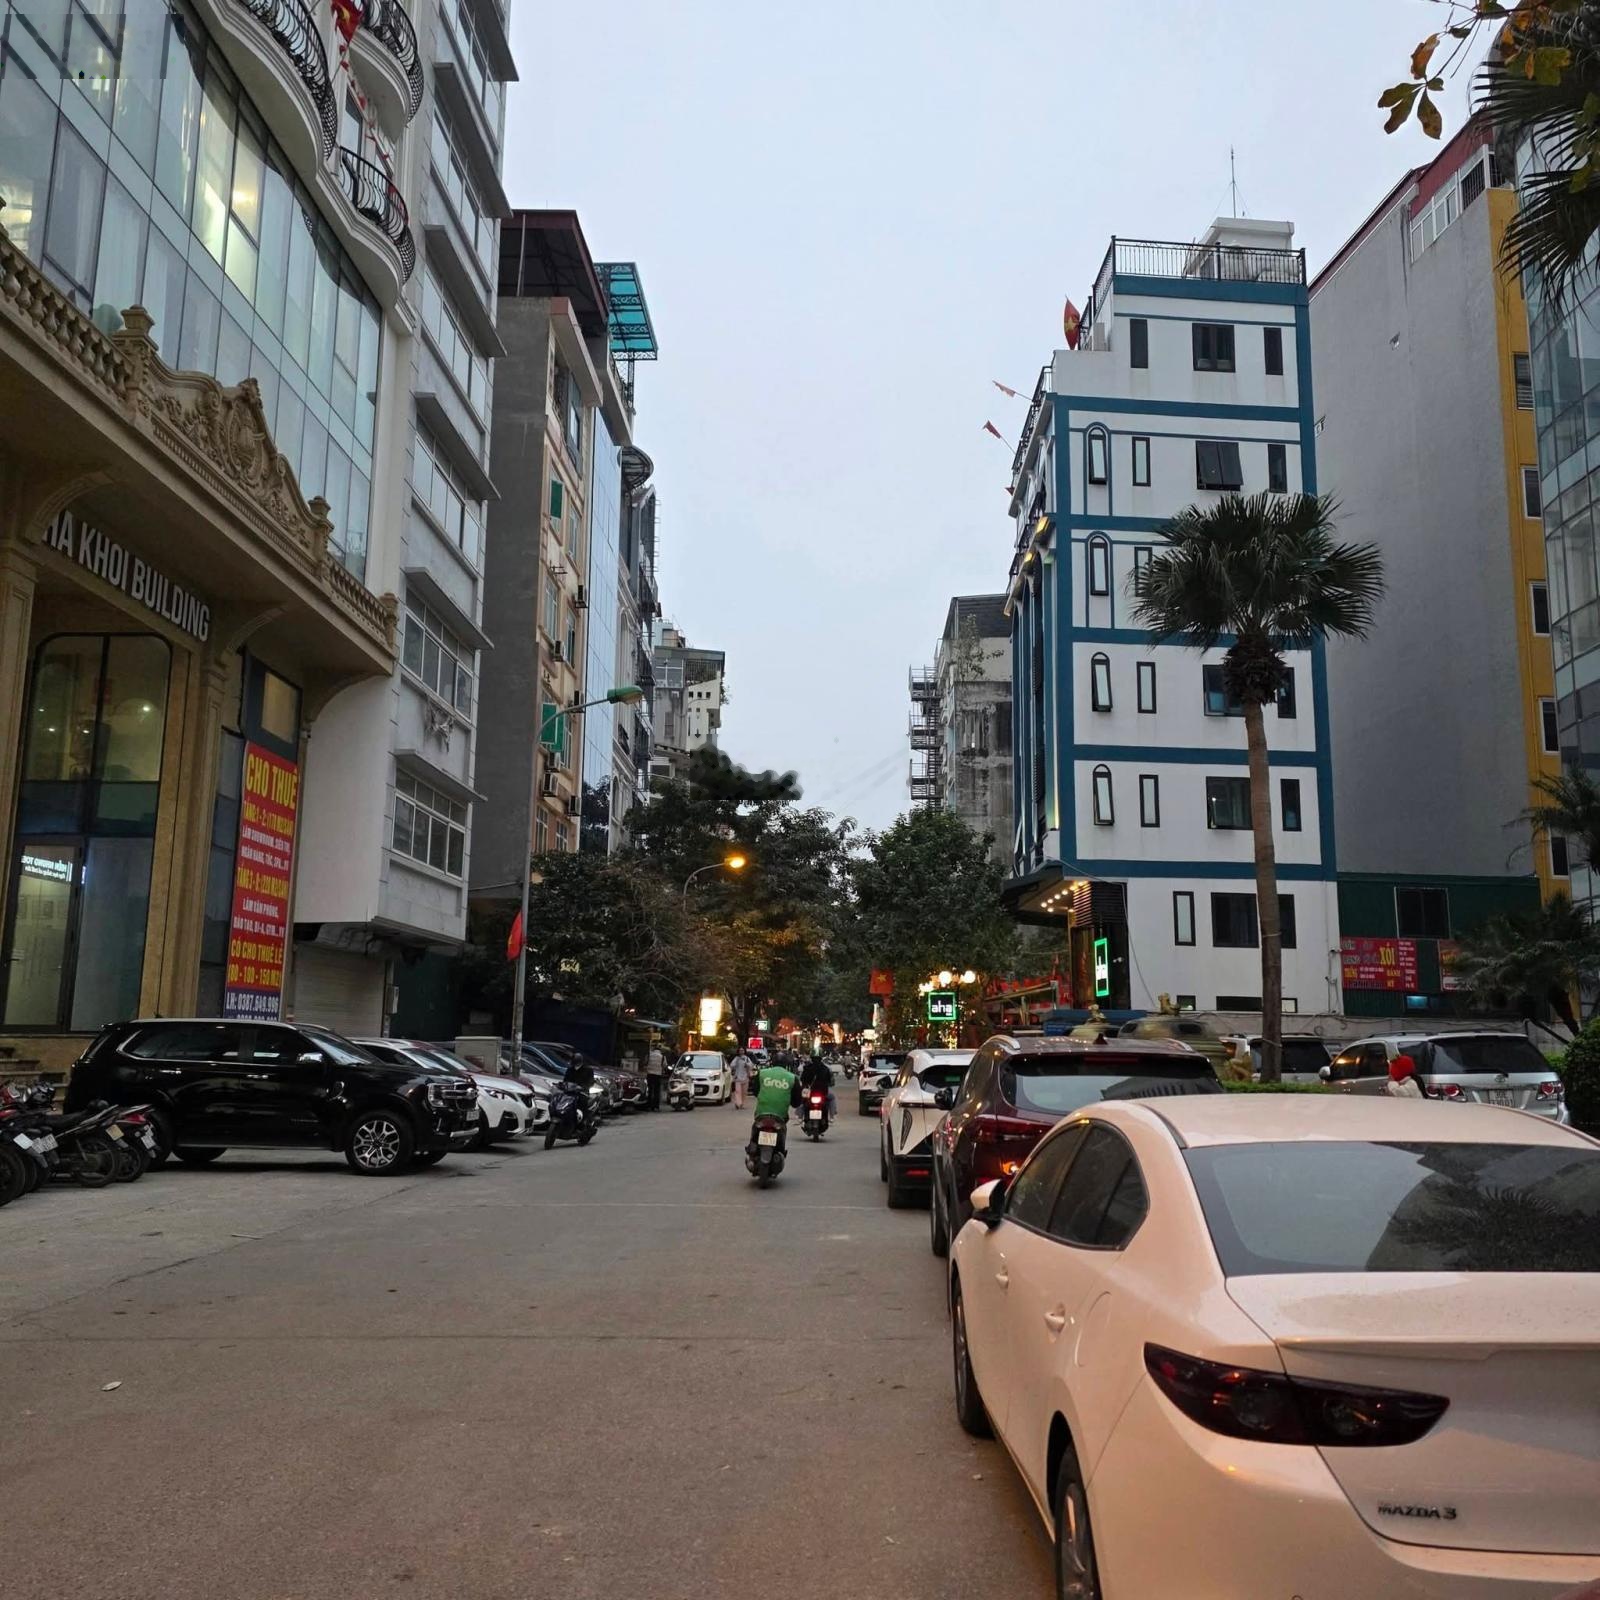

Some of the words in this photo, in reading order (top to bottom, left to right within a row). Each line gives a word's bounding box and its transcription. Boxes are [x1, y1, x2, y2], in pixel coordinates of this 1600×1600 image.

[78, 522, 129, 591] KHOI
[131, 557, 210, 642] BUILDING
[246, 753, 269, 798] CHO
[272, 766, 298, 810] THUÊ
[242, 941, 257, 961] CHO
[226, 991, 237, 1011] LH:
[763, 1077, 790, 1090] Grab
[1378, 1506, 1440, 1519] MAZDA
[1443, 1507, 1457, 1520] 3
